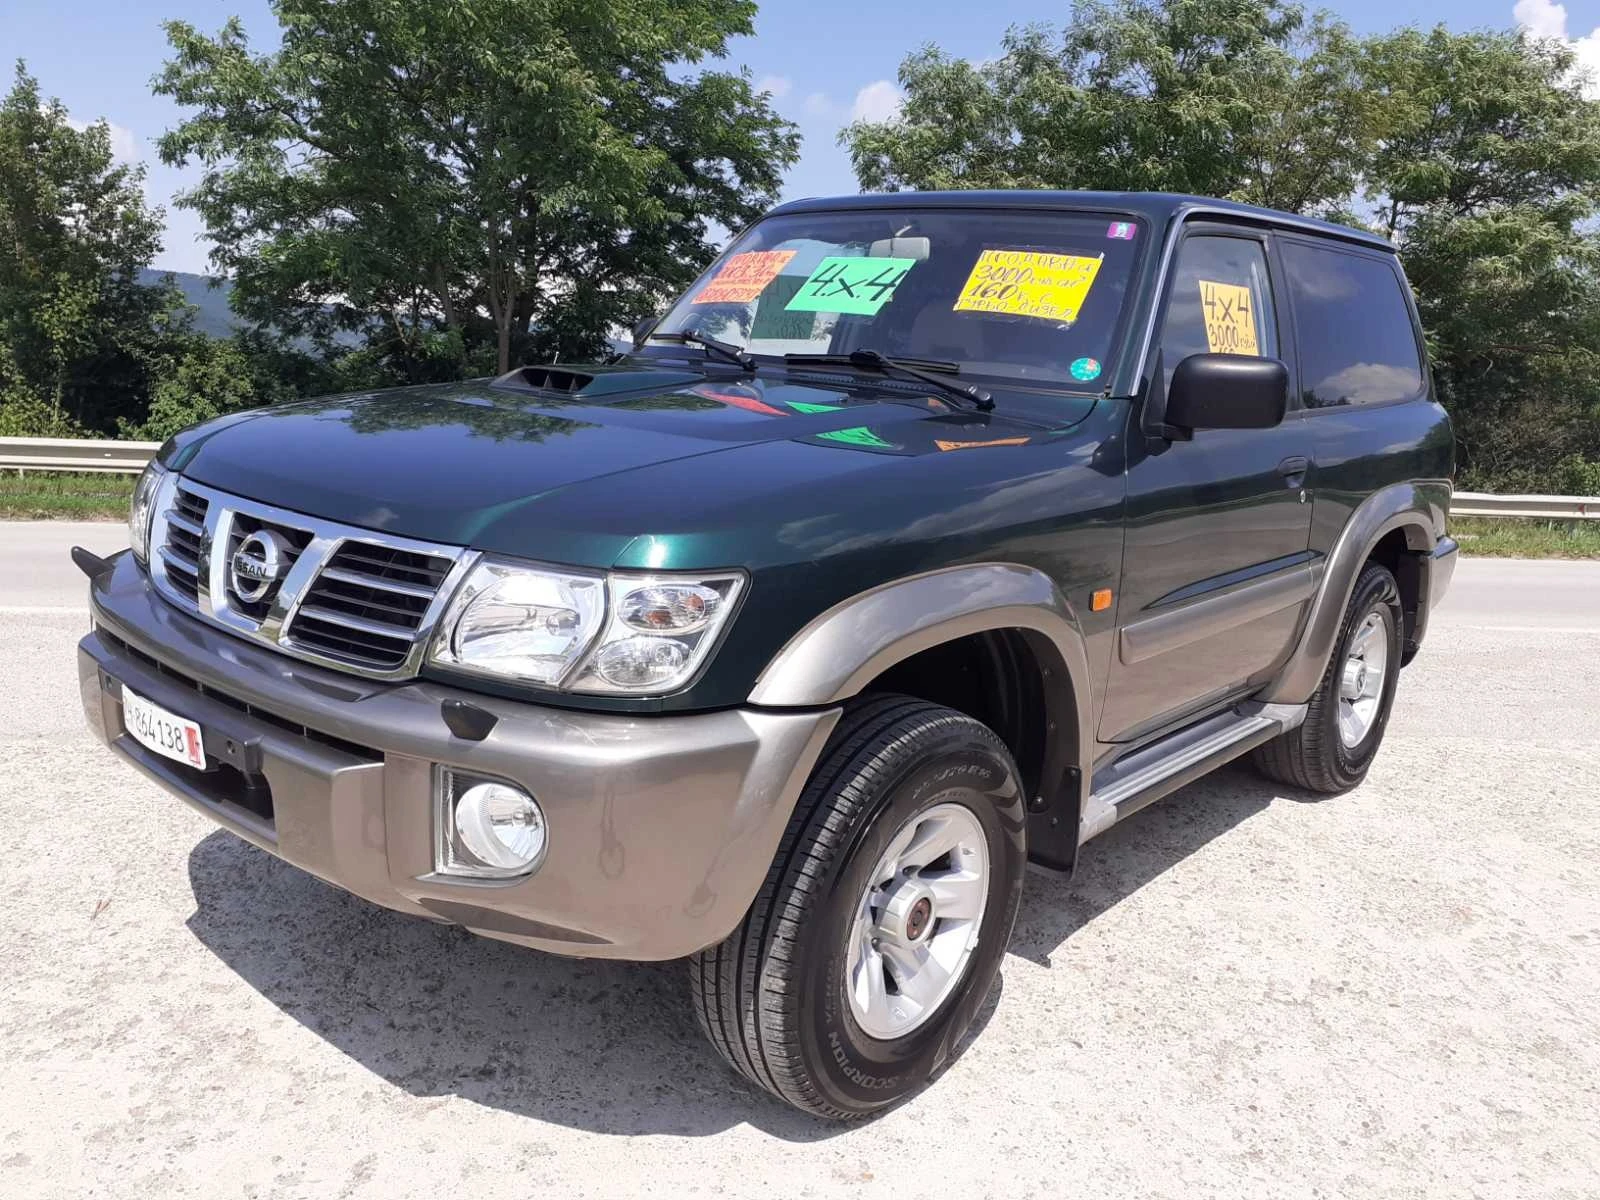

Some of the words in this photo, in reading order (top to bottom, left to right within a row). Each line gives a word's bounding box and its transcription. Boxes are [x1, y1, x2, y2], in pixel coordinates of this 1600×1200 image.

[974, 265, 1034, 284] 3000
[968, 280, 1019, 301] 160
[1208, 323, 1239, 348] 3000
[828, 1030, 899, 1089] SCORPION
